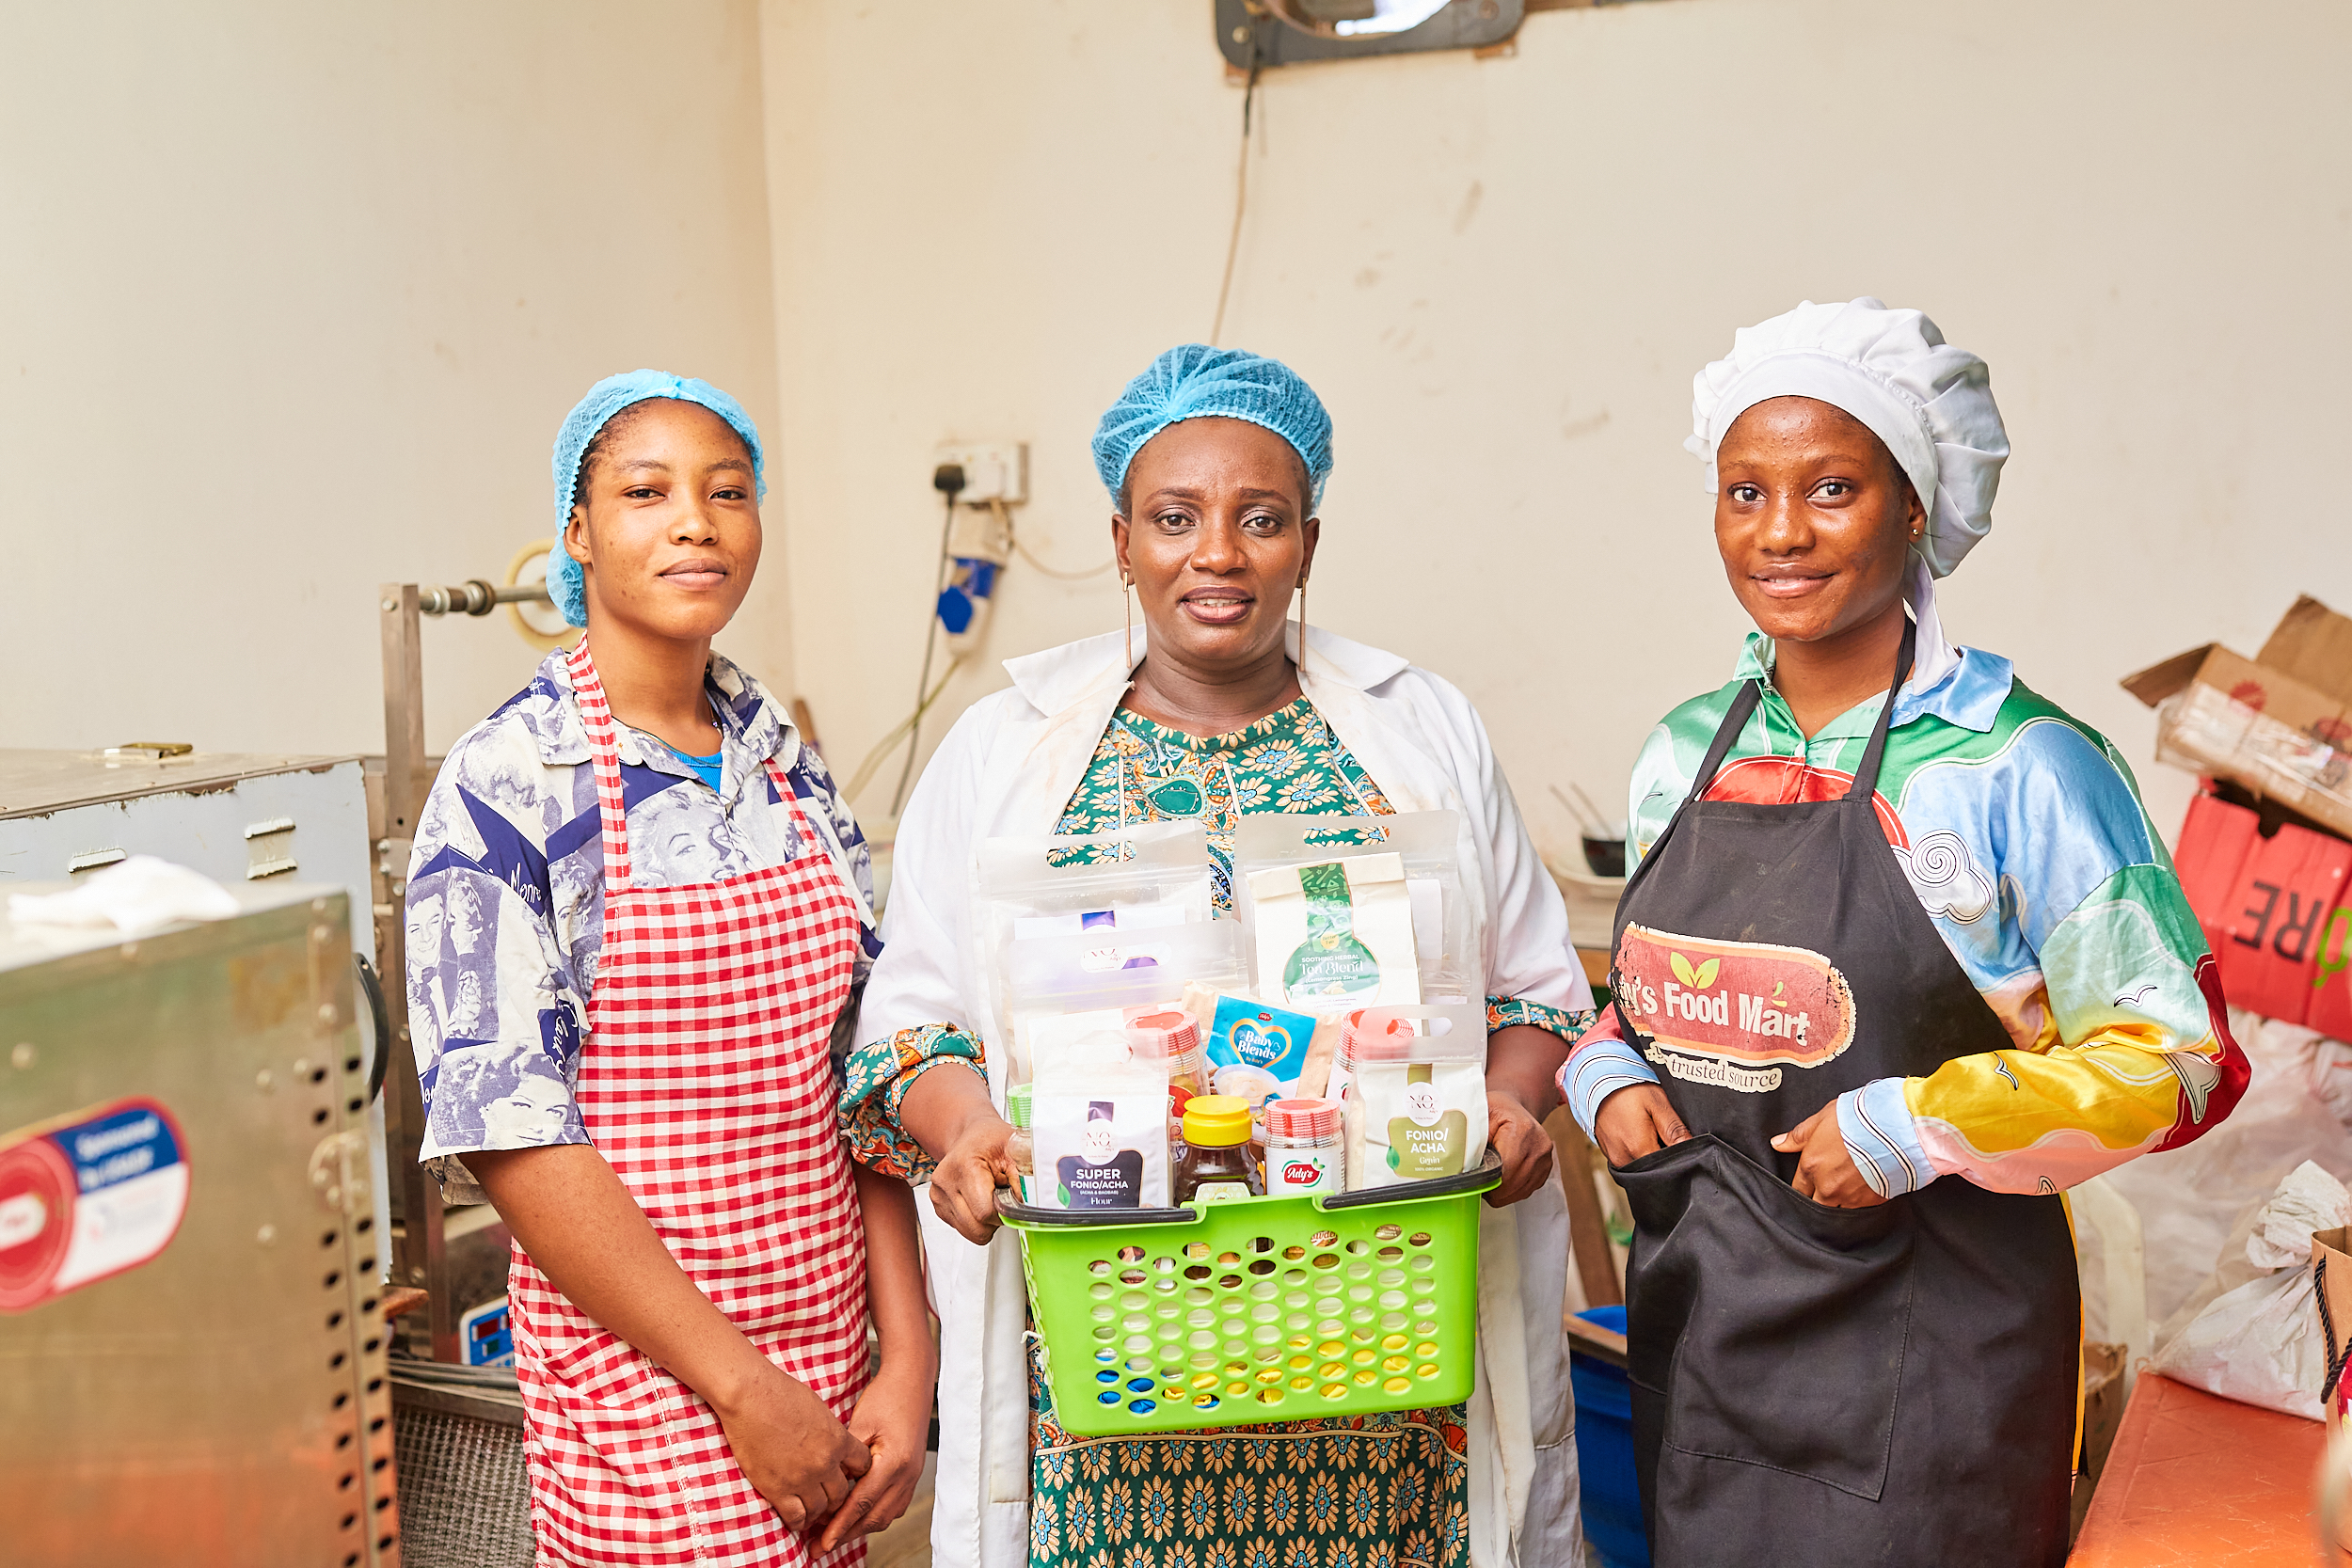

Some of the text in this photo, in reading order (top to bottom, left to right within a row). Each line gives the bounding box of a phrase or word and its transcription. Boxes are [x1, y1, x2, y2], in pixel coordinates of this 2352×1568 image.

[1299, 960, 1364, 975] Tea Blend
[1663, 981, 1729, 1026] Food
[1738, 992, 1811, 1047] Mart
[1245, 1030, 1273, 1048] Baby
[1237, 1039, 1277, 1060] Blends
[1671, 1058, 1777, 1088] trusted source
[1406, 1128, 1449, 1142] FONIO/
[1410, 1142, 1446, 1154] ACHA
[1419, 1156, 1440, 1165] Grain
[1075, 1168, 1121, 1180] SUPER
[1286, 1166, 1314, 1183] Ady's
[1071, 1180, 1129, 1190] FONIO/ACHA
[1090, 1196, 1113, 1205] Flour
